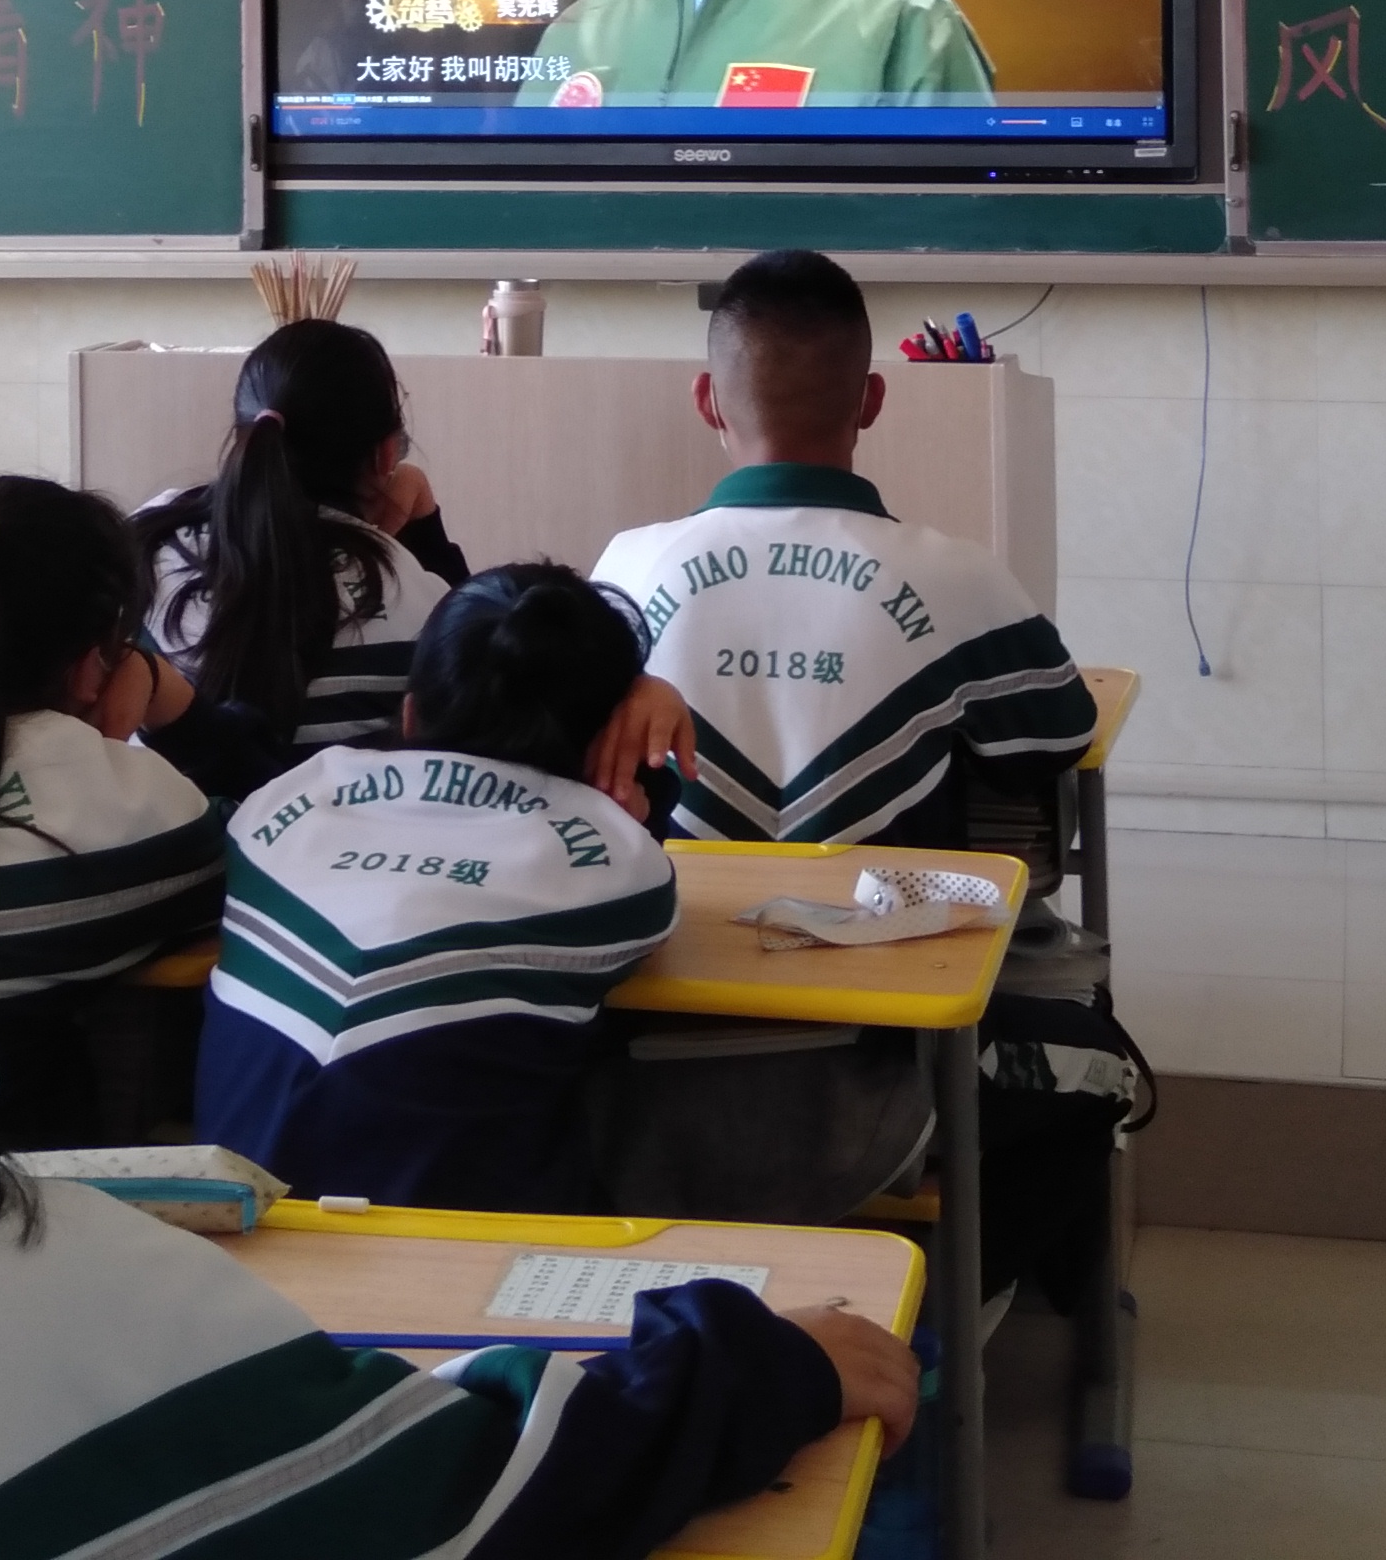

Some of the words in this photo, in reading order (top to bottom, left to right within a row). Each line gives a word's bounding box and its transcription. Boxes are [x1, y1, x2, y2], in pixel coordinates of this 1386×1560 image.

[356, 55, 435, 83] 大家好
[441, 54, 572, 83] 我叫胡双钱
[674, 148, 731, 162] seewo
[680, 545, 749, 596] JIAO
[768, 543, 881, 593] ZHONG
[879, 581, 935, 643] XIN
[716, 648, 845, 684] 2018级
[252, 793, 315, 847] ZHI
[331, 765, 405, 808] JIAO
[419, 758, 550, 815] ZHONG
[548, 816, 611, 869] XIN
[330, 851, 493, 887] 2018级
